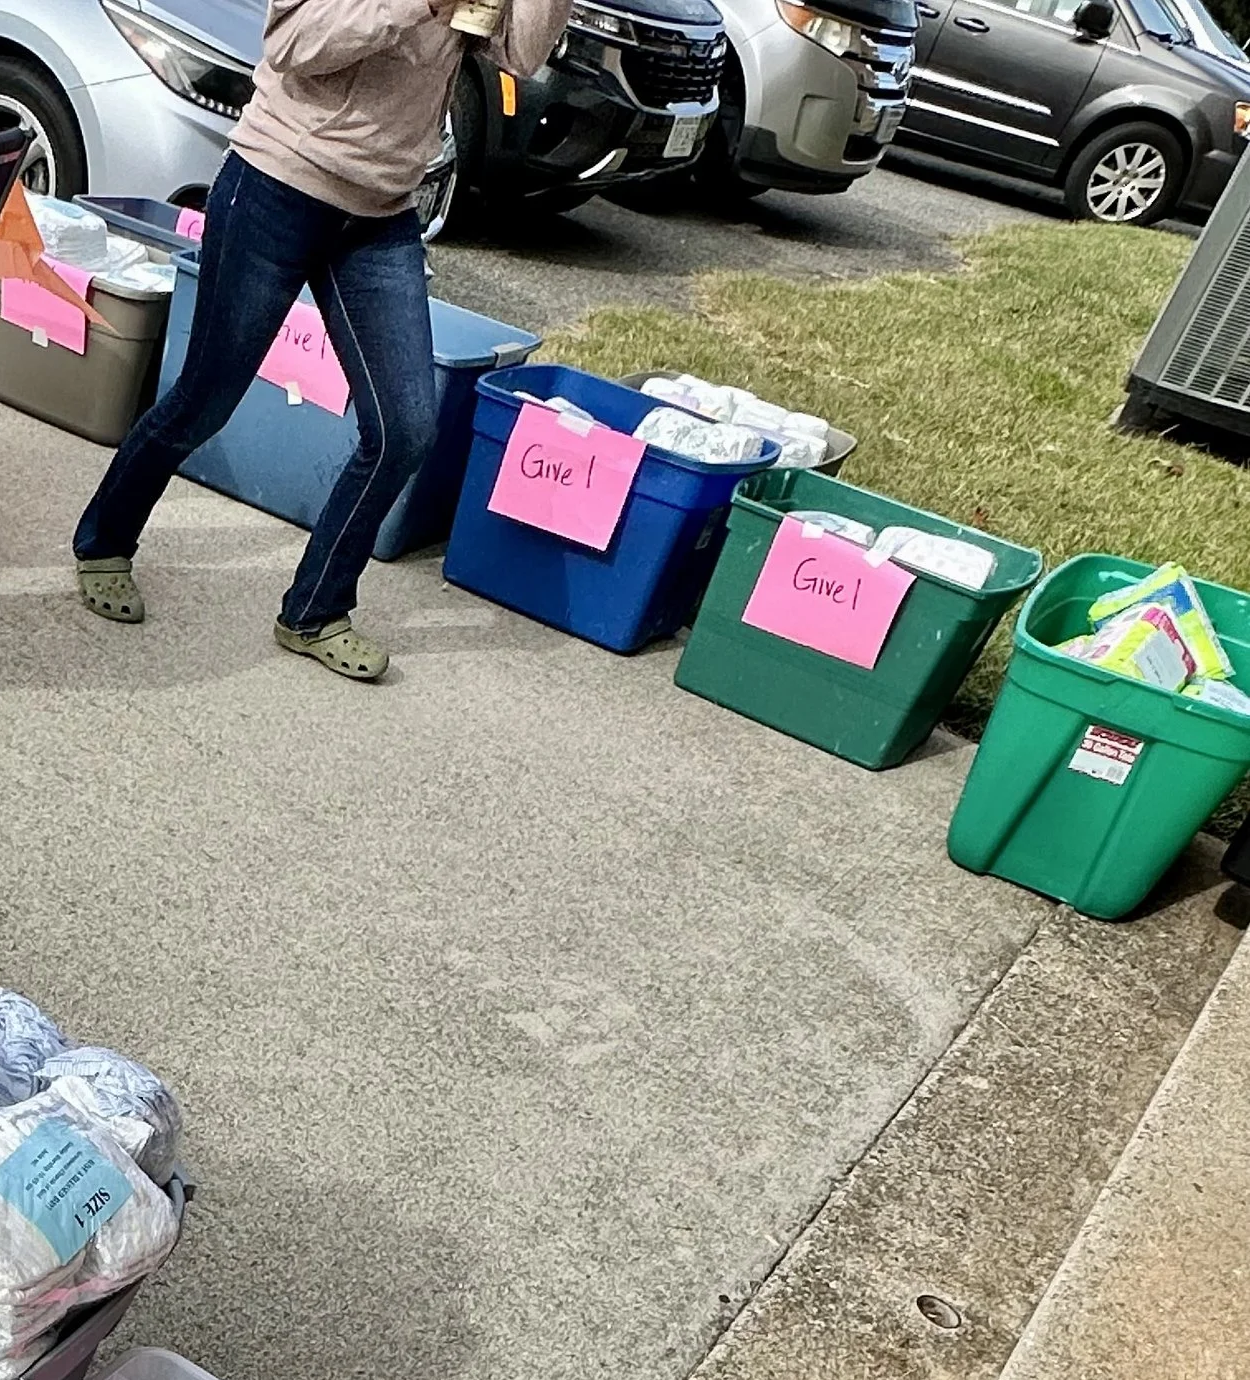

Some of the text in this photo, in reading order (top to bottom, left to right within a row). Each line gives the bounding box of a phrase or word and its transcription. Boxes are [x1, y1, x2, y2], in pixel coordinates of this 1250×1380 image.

[521, 443, 574, 486] Give
[793, 557, 847, 604] Give
[82, 1188, 110, 1217] SIZE
